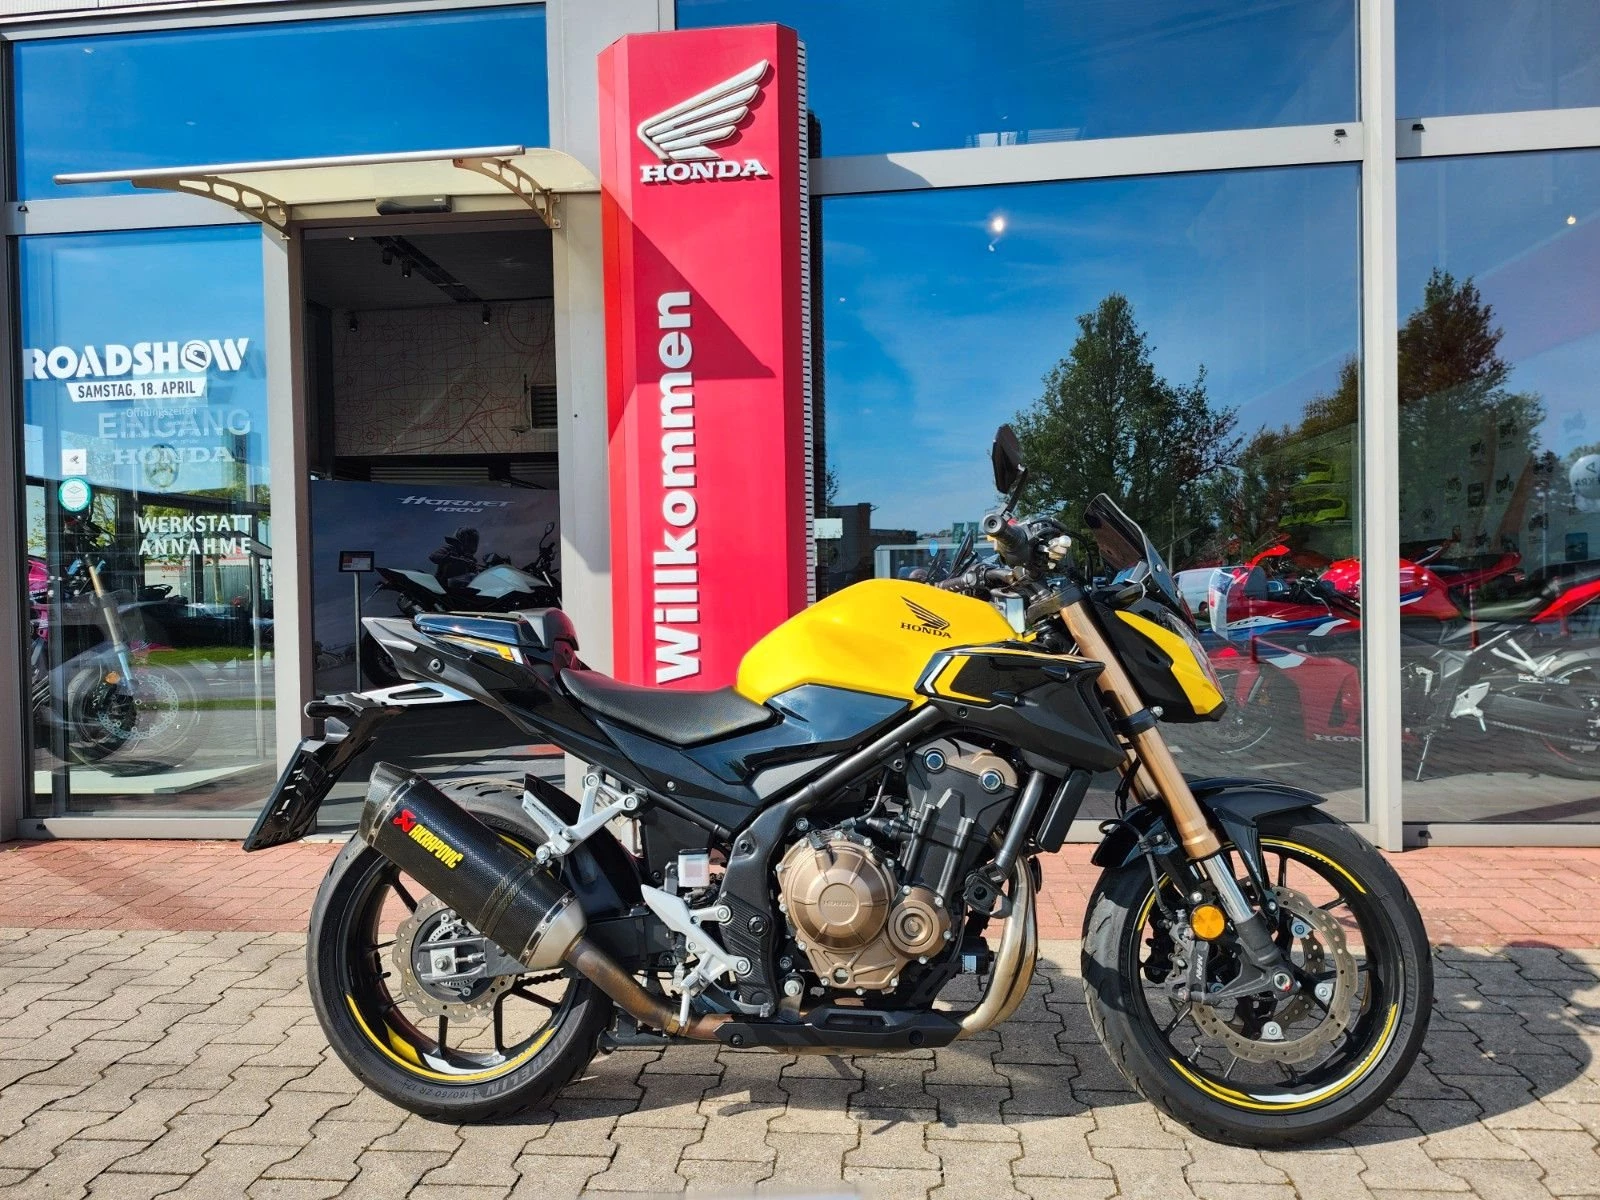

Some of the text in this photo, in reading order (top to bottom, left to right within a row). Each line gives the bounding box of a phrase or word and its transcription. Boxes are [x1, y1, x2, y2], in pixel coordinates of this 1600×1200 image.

[639, 159, 769, 183] HONDA
[23, 337, 249, 380] ROADSHOW
[78, 380, 196, 399] SAMSTAG, 18. APRIL
[98, 408, 251, 439] EINGANG
[113, 446, 236, 465] HONDA
[653, 291, 700, 684] Willkommen
[138, 514, 253, 533] WERKSTATT
[138, 537, 252, 556] ANNAHME
[900, 621, 952, 639] HONDA
